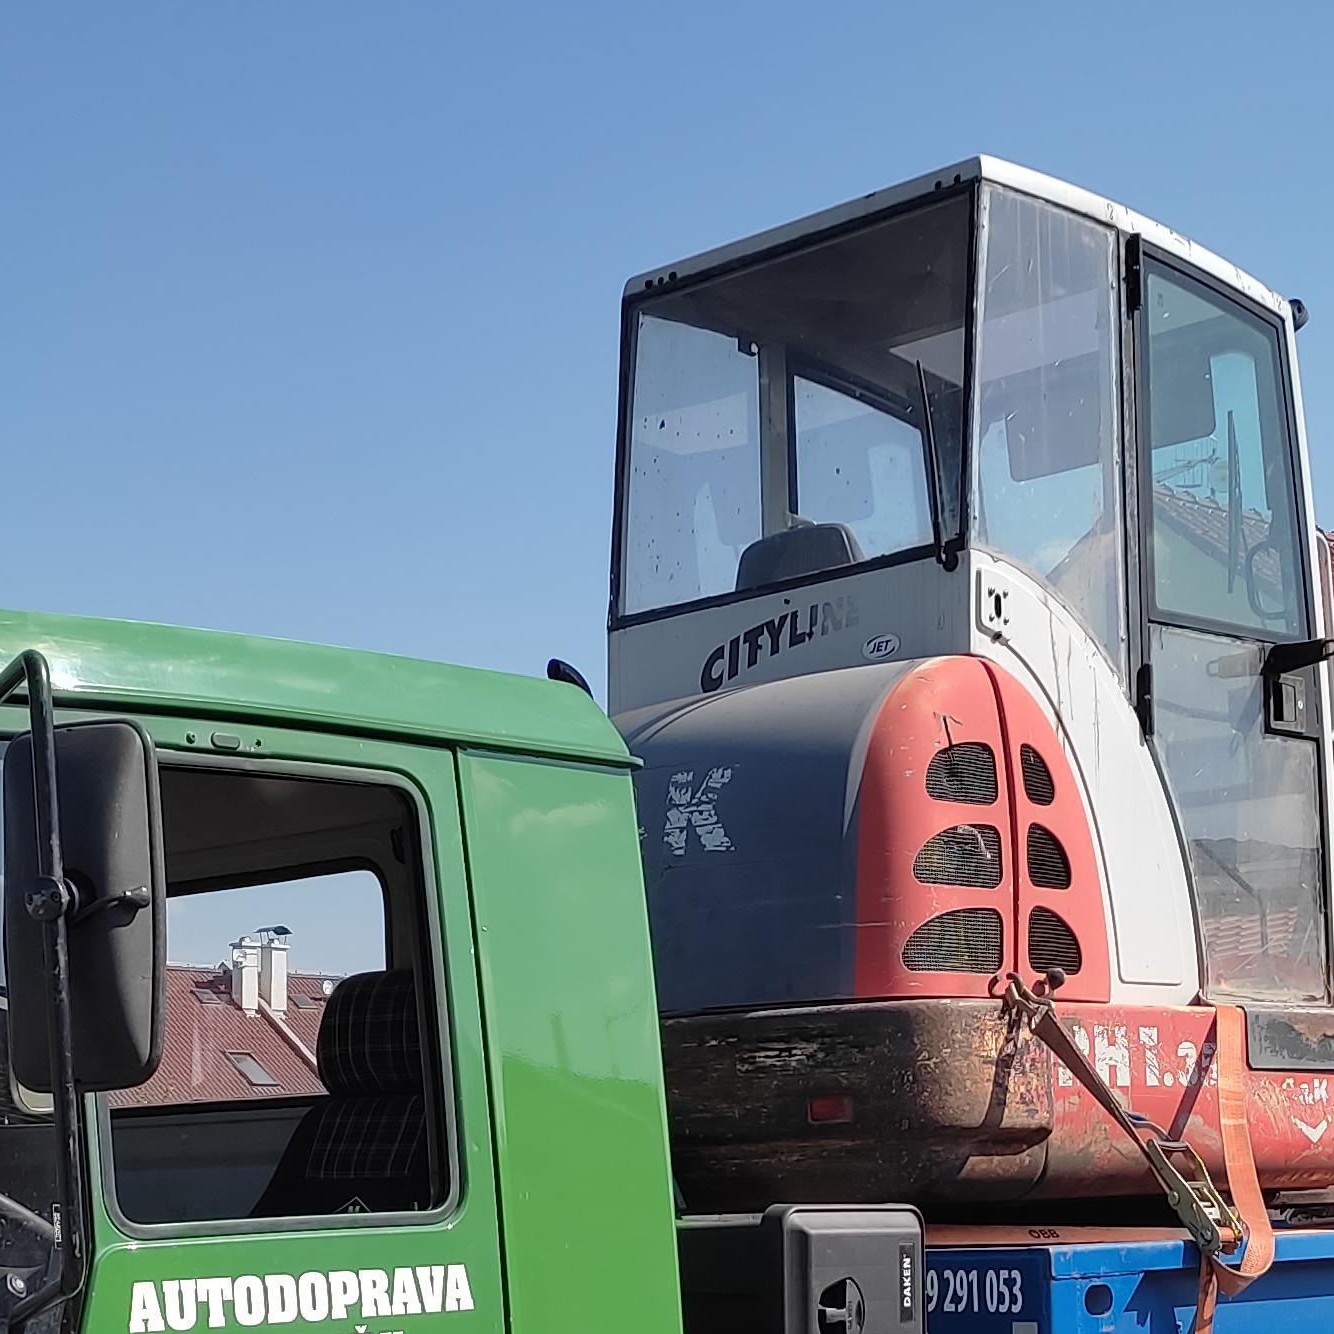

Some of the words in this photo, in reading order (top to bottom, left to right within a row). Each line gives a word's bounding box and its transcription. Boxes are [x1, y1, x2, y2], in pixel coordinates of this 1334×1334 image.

[869, 638, 892, 655] JET
[128, 1263, 476, 1334] AUTODOPRAVA
[903, 1256, 912, 1308] DAKEN
[943, 1269, 979, 1313] 291
[985, 1269, 1023, 1314] 053
